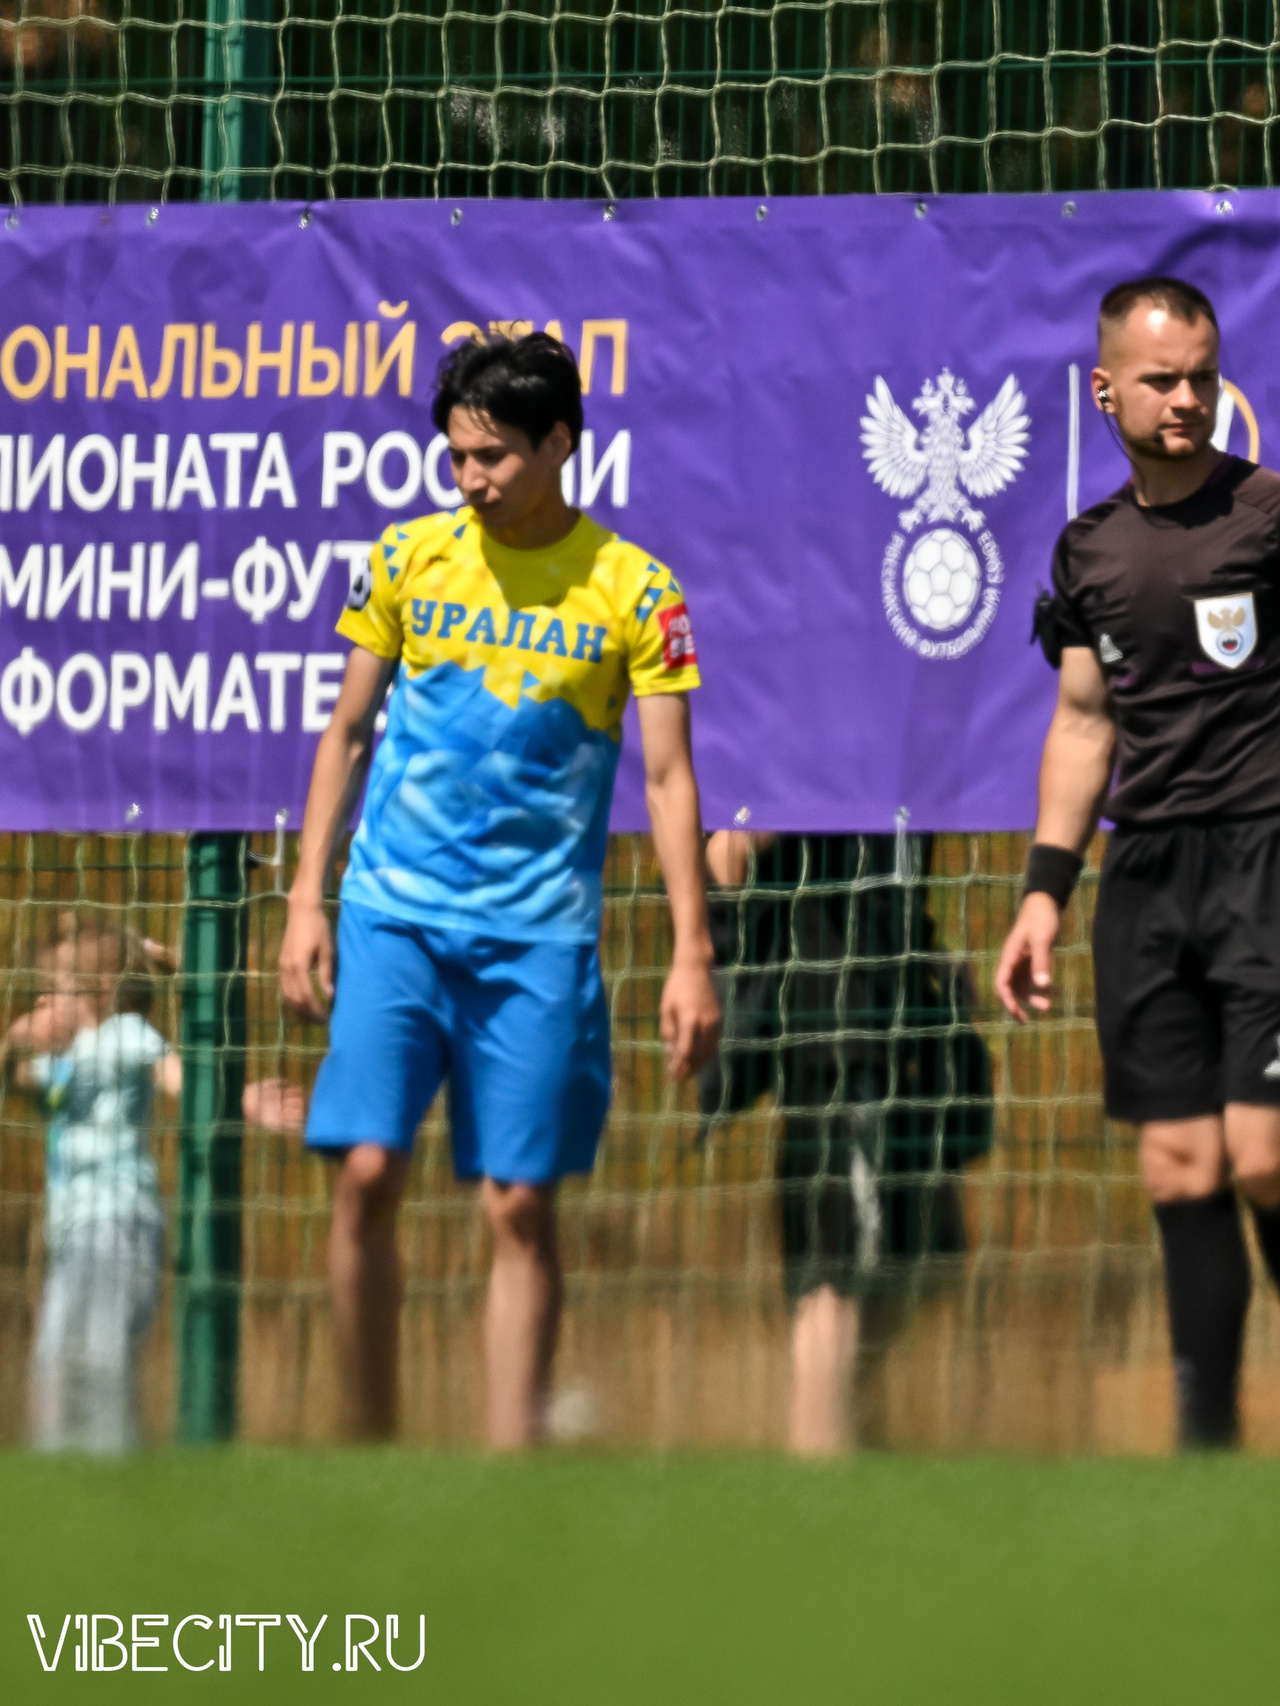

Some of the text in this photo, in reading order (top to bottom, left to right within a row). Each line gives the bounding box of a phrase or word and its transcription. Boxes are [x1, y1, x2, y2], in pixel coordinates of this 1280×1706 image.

[0, 301, 416, 399] ОНАЛЬНЫЙ
[0, 430, 632, 511] ИОНАТА РОСИ
[411, 598, 607, 664] УРАЛАН
[0, 646, 345, 736] ФОРМАТЕ
